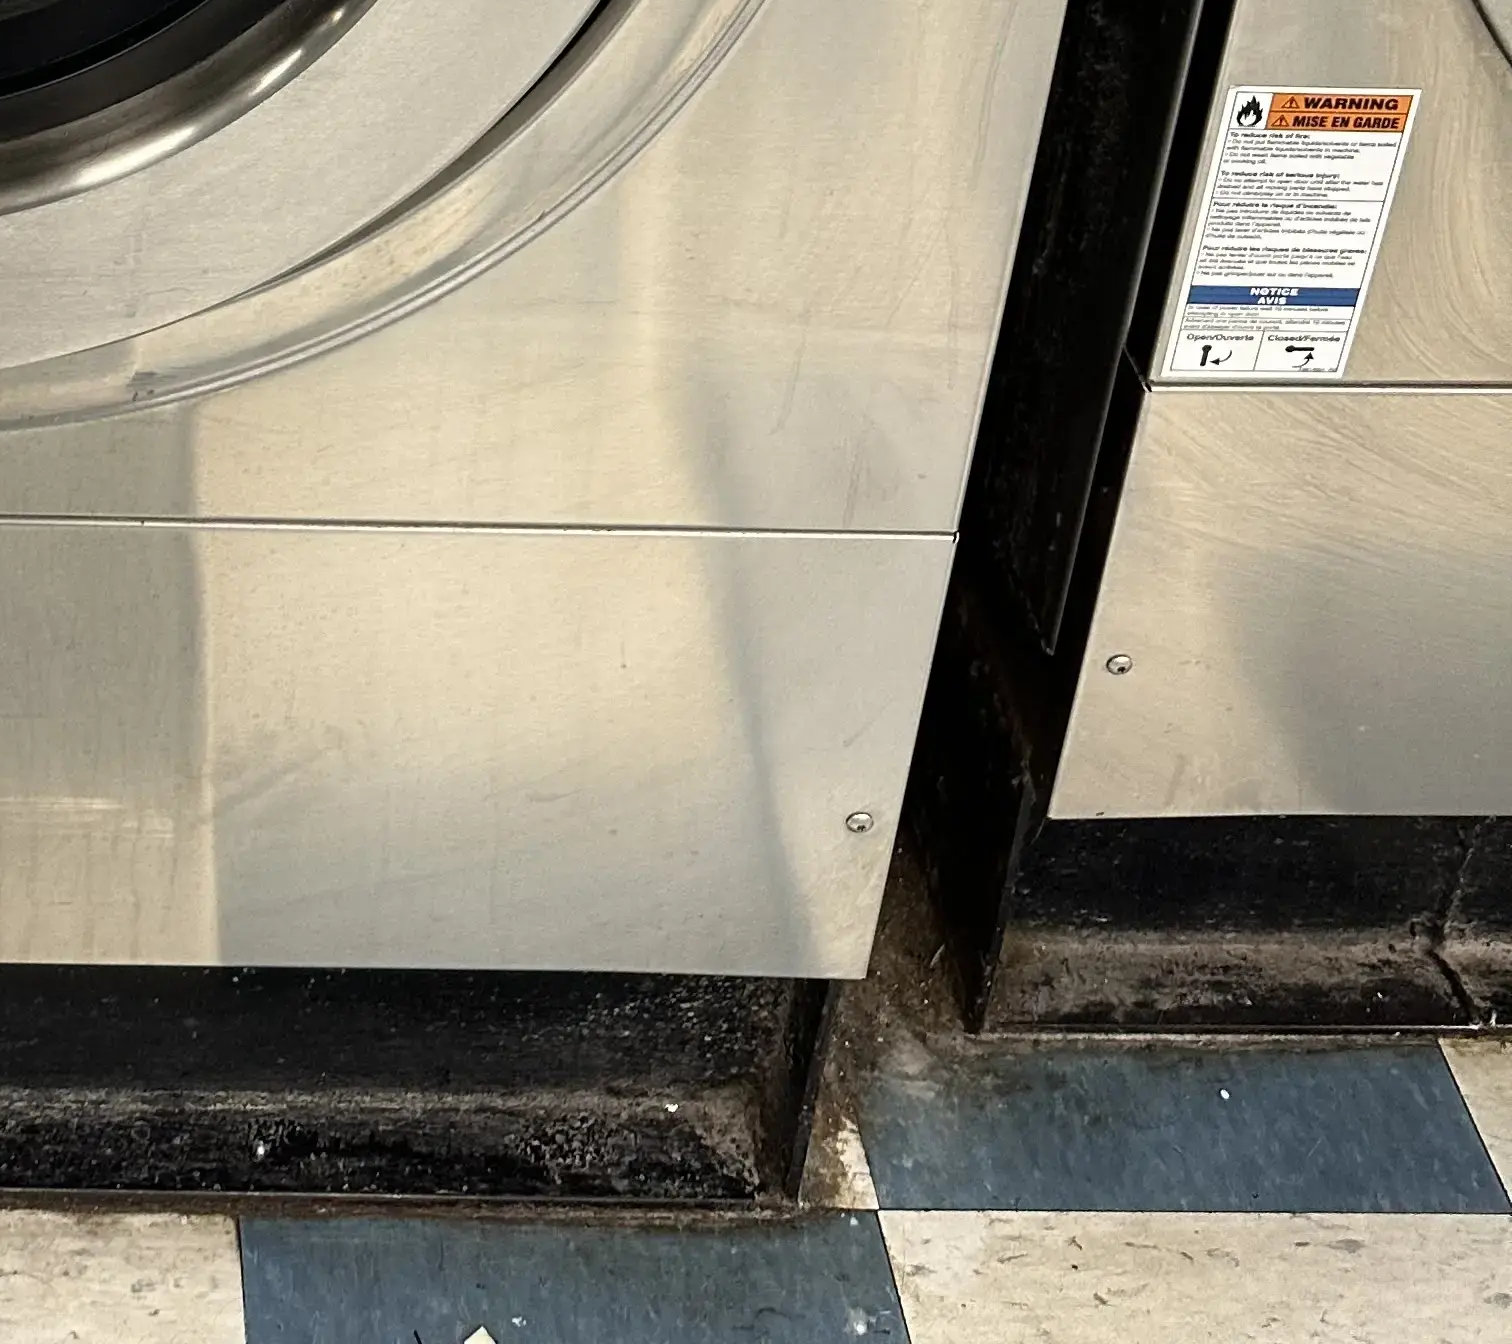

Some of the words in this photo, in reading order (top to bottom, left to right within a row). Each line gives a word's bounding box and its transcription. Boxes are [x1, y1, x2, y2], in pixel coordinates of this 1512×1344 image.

[1303, 97, 1398, 111] WARNING
[1293, 115, 1328, 128] MISE
[1331, 116, 1352, 128] EN
[1355, 116, 1400, 129] GARDE
[1250, 288, 1299, 296] NOTICE
